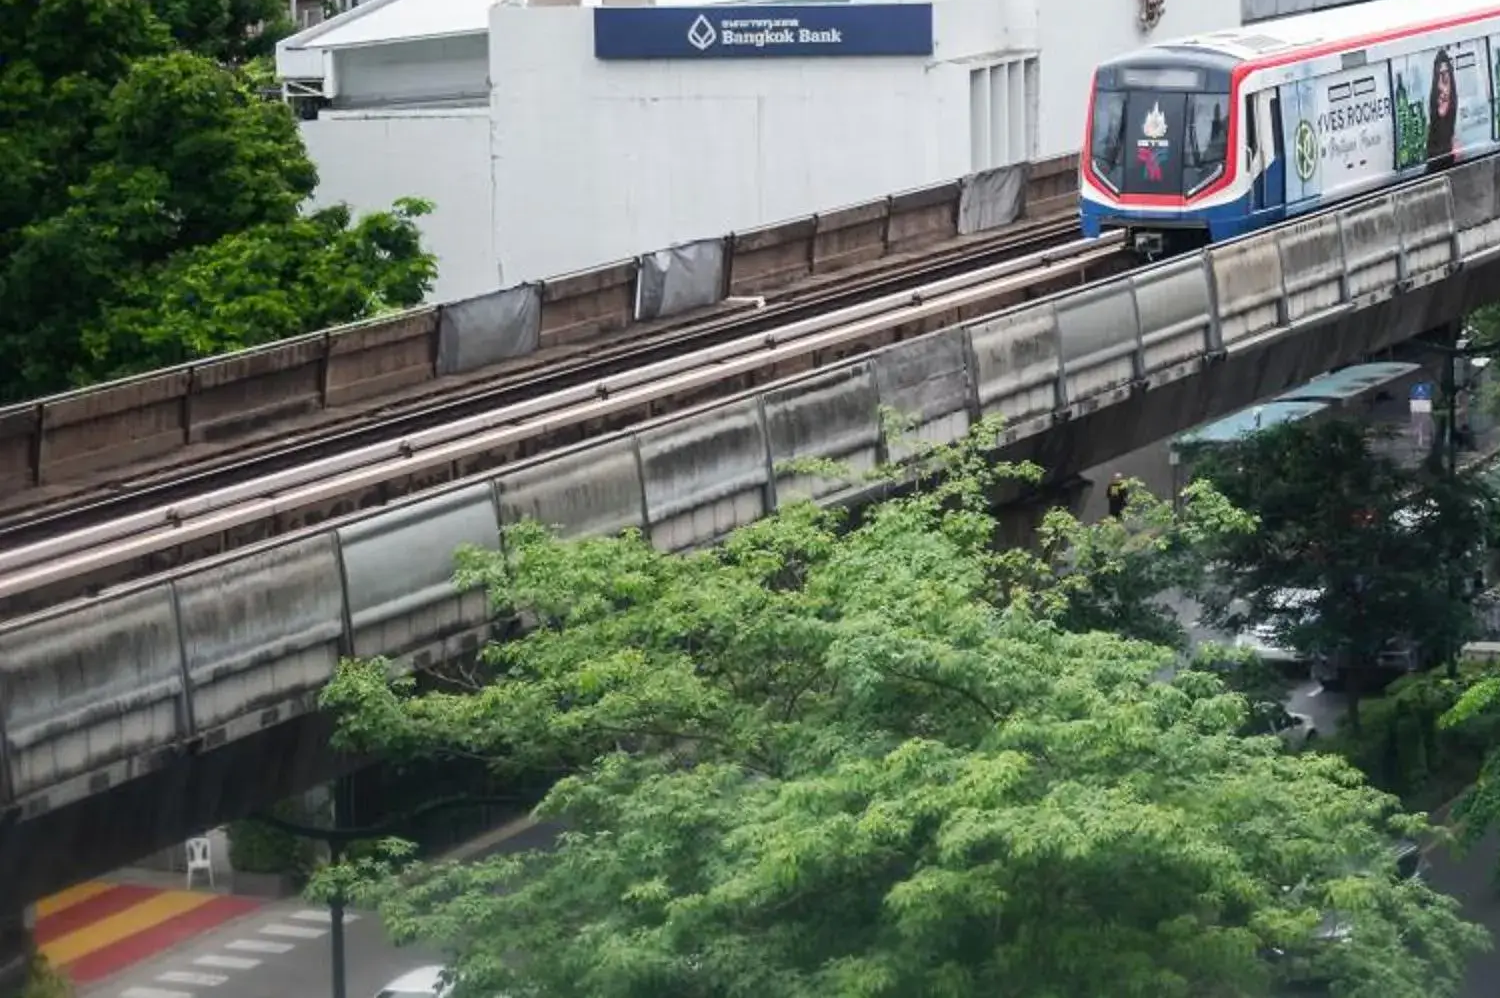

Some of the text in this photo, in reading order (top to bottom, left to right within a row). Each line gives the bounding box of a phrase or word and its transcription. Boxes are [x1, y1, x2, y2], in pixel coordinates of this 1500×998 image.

[721, 28, 842, 47] Bangkok Bank
[1317, 97, 1392, 134] YVES ROCHER
